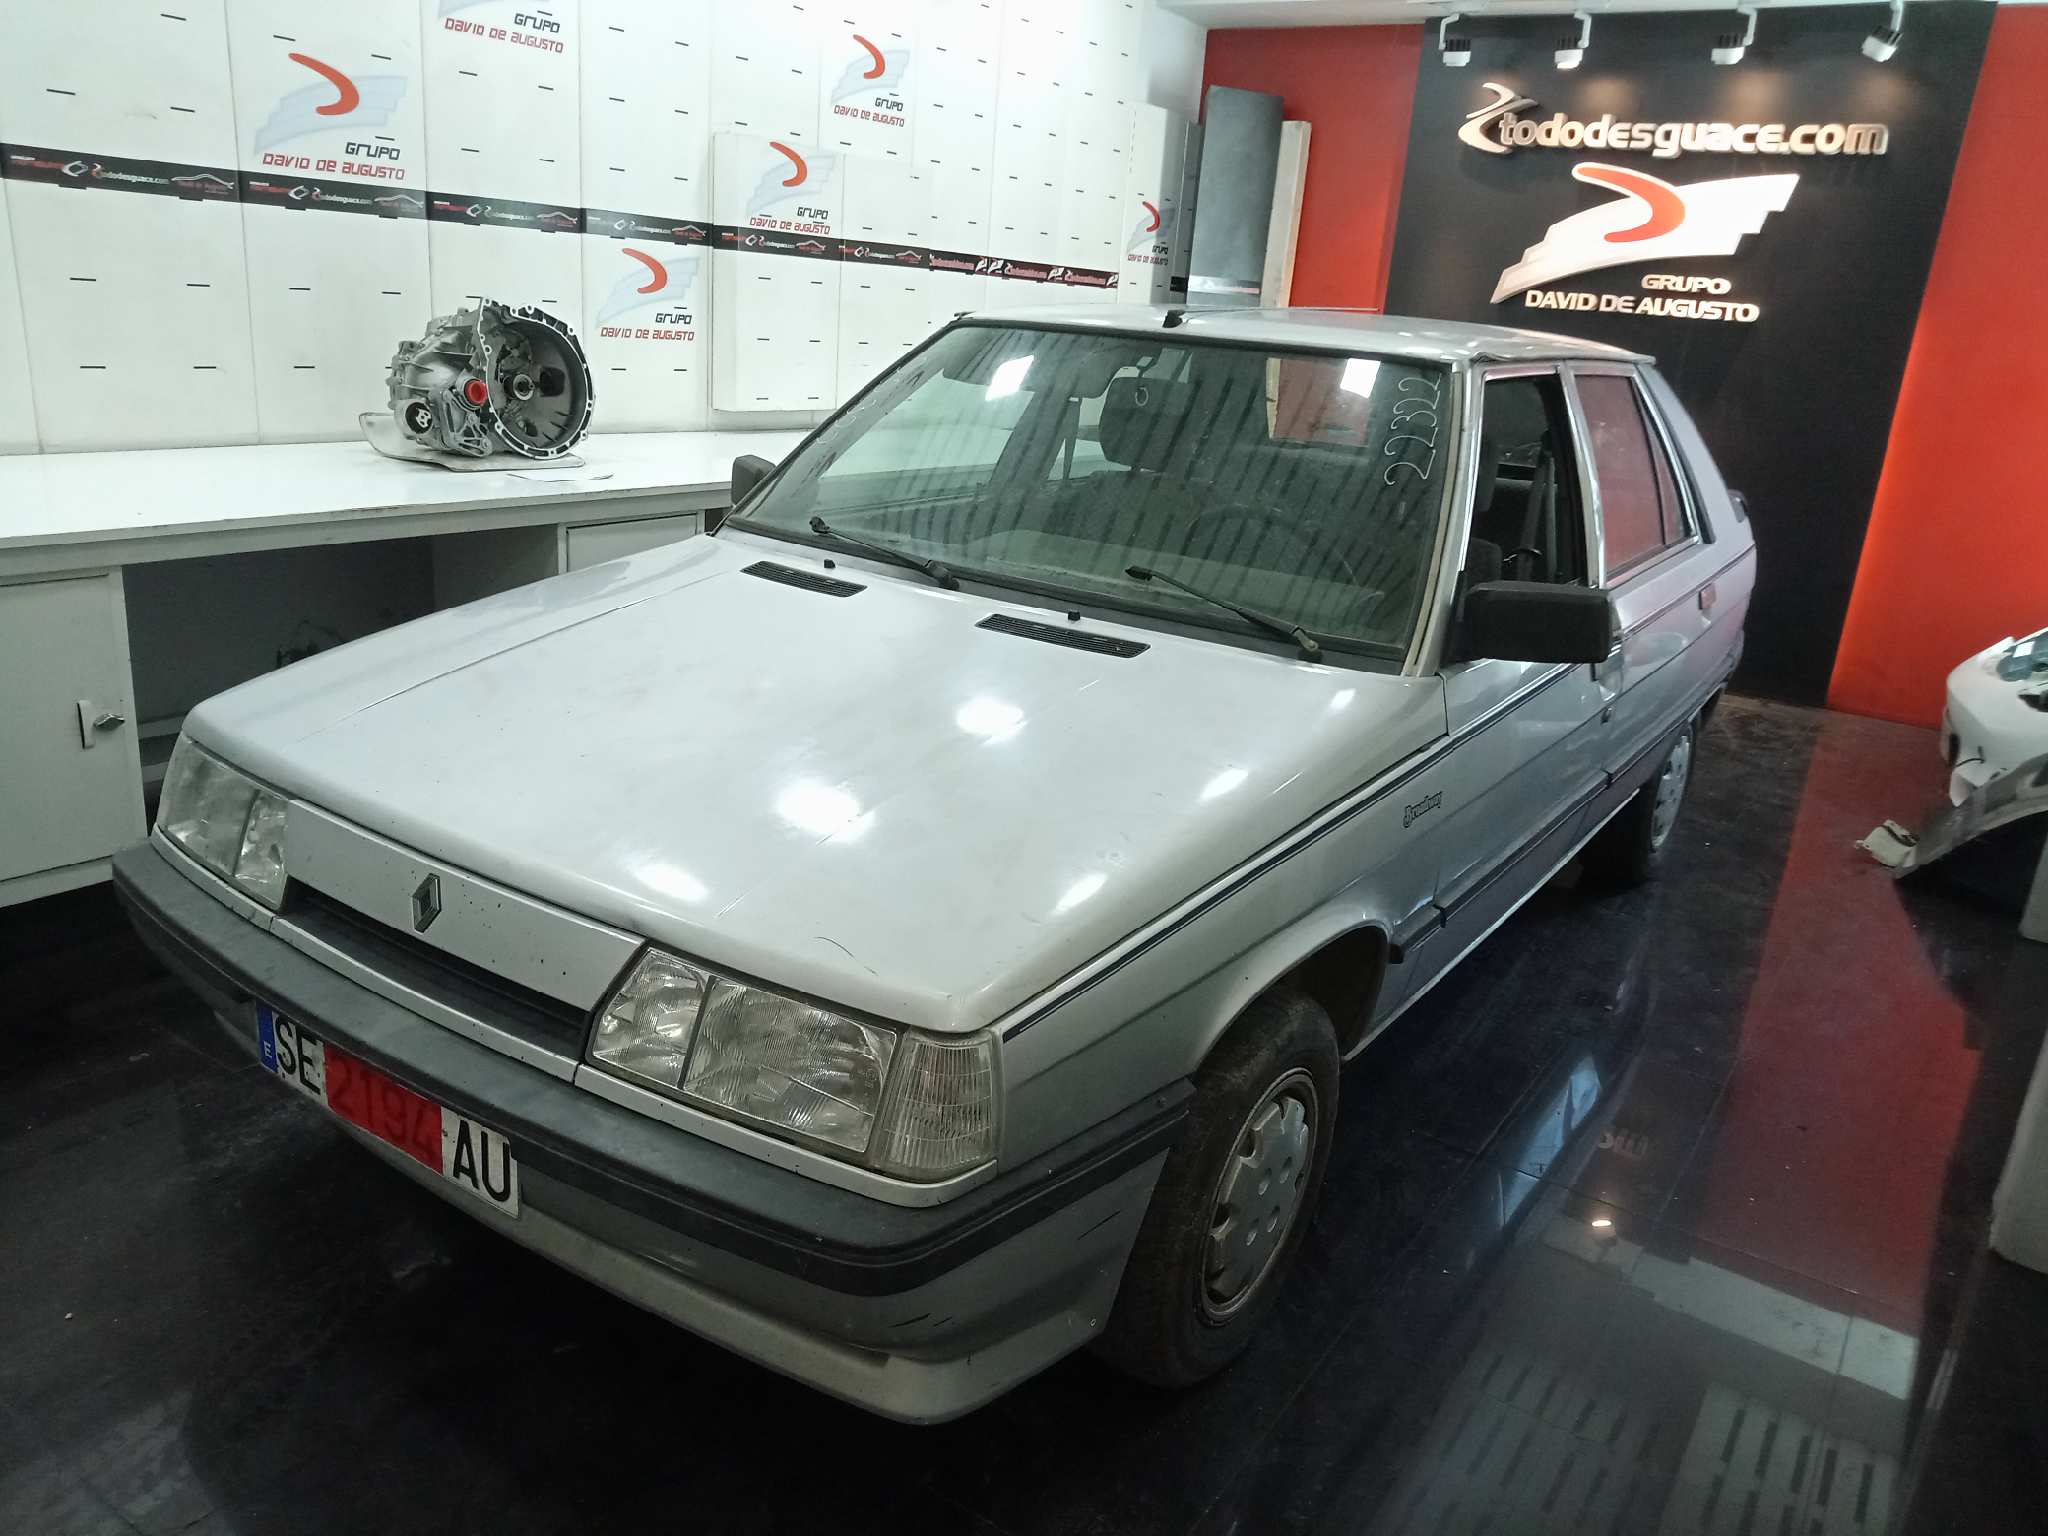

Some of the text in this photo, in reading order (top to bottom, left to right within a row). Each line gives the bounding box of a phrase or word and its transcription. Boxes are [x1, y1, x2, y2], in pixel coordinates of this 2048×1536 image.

[514, 13, 560, 33] GRUPO
[445, 18, 564, 53] DAVID DE AUGUSTO
[1500, 112, 1890, 159] tododesguace.com
[345, 142, 400, 160] GRUPO
[262, 153, 405, 180] DAVID DE AUGUSTO
[797, 207, 828, 219] GRUPO
[1641, 274, 1732, 295] GRUPO
[1525, 290, 1760, 322] DAVID DE AUGUSTO
[655, 313, 692, 324] GRUPO
[601, 327, 632, 338] DAVID
[652, 330, 695, 341] AUGUSTO
[275, 1015, 324, 1096] SE
[452, 1119, 512, 1203] AU
